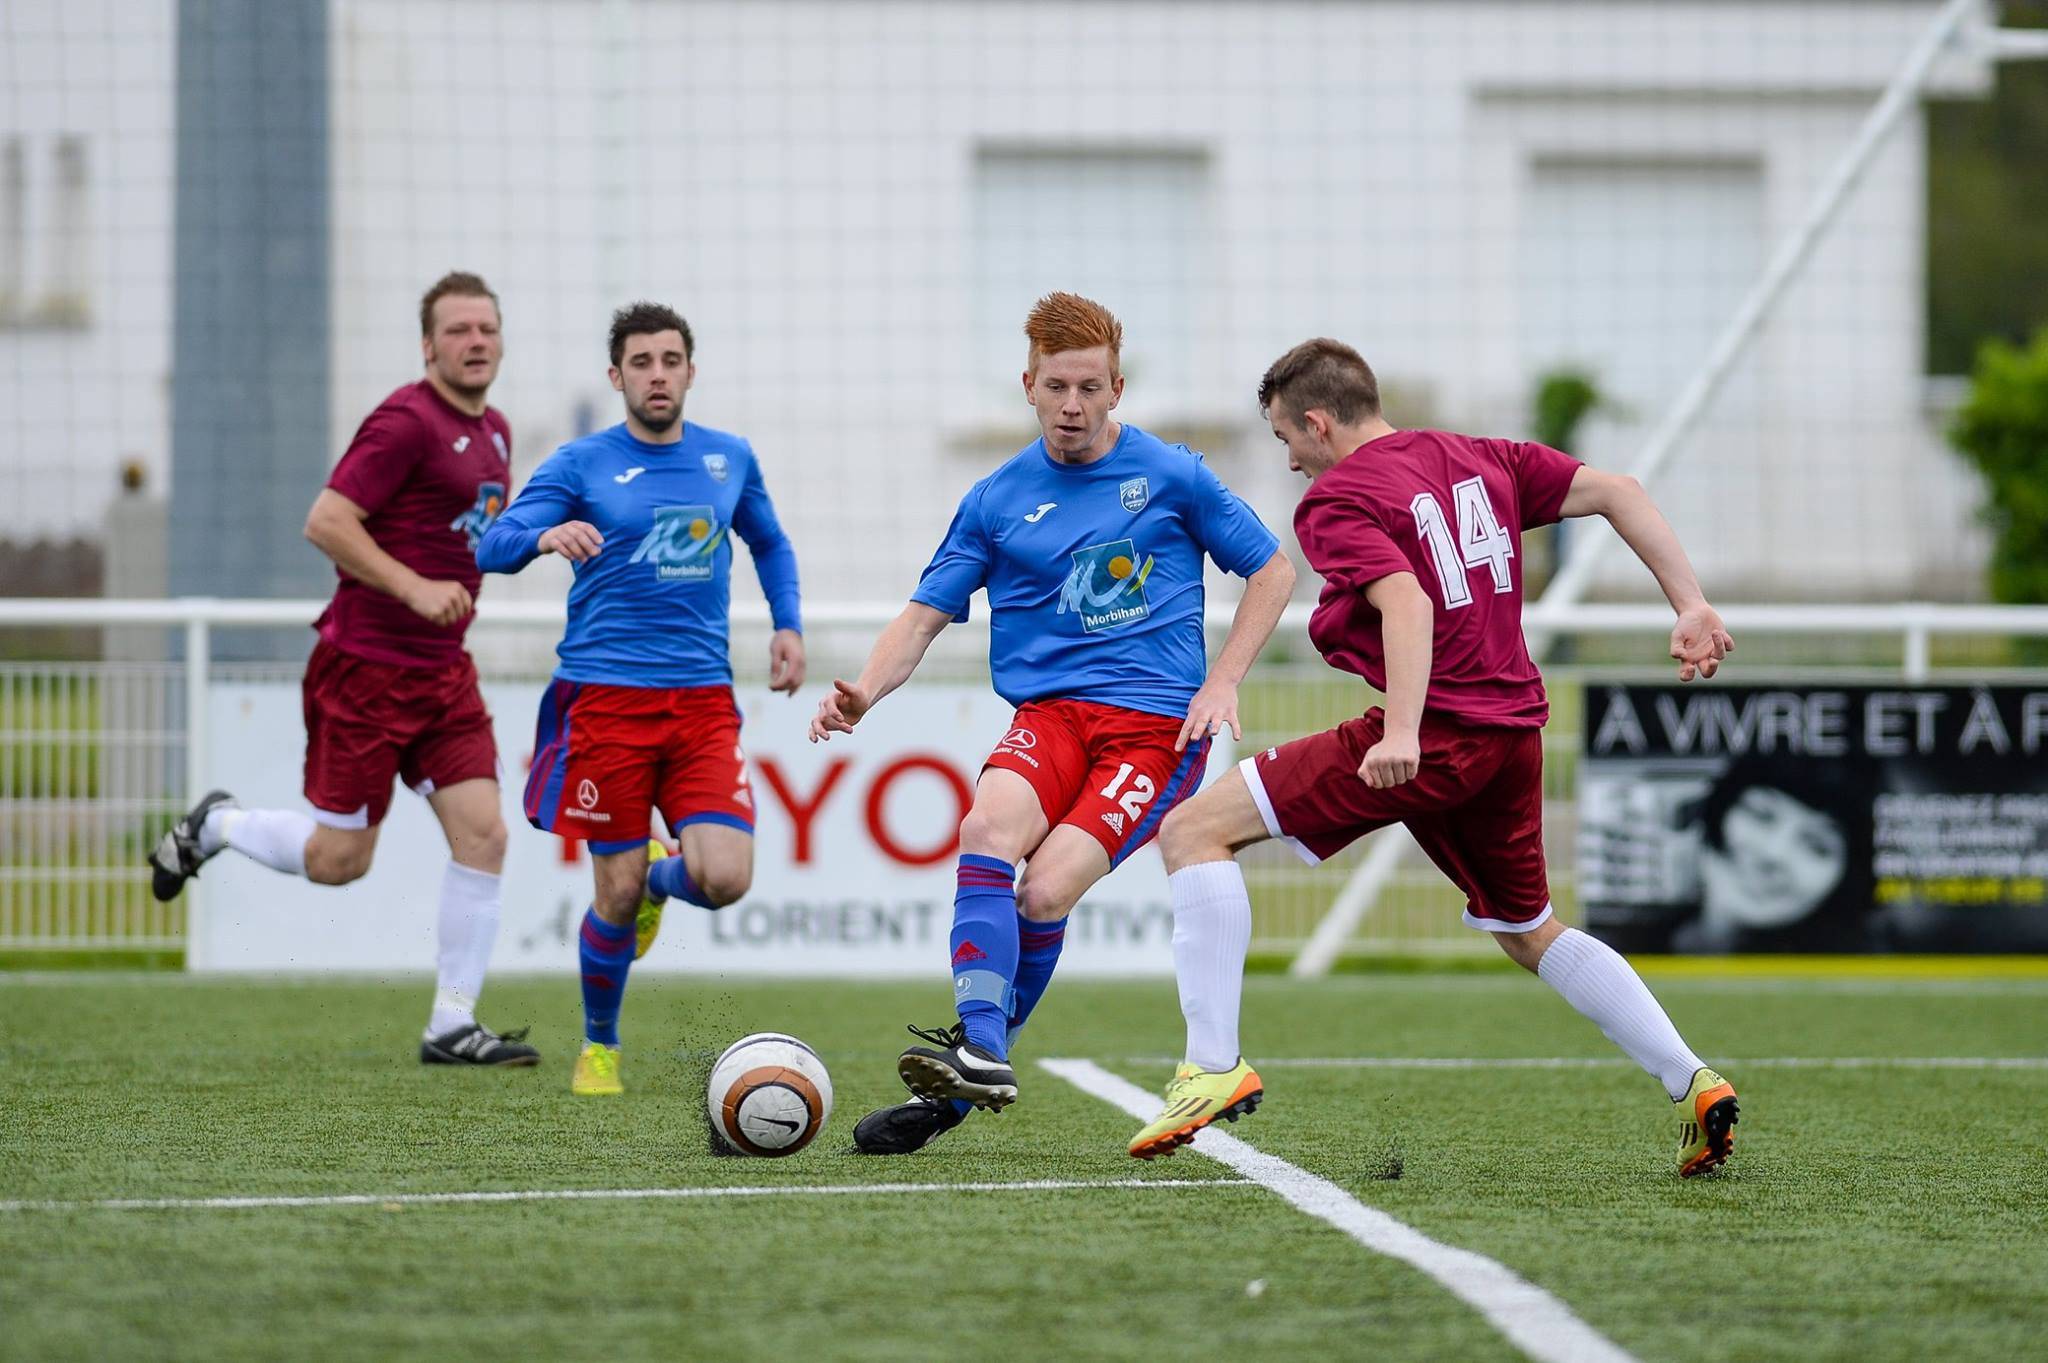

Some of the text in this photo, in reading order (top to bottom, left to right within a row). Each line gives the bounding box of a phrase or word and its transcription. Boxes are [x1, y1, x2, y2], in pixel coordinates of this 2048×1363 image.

[1409, 475, 1515, 610] 14
[660, 565, 710, 577] Morbihan
[1085, 607, 1144, 628] Morbihan
[1593, 684, 1648, 755] À
[1655, 691, 1850, 757] VIVRE
[1864, 691, 1949, 757] ET
[1958, 683, 2012, 755] À
[1100, 762, 1155, 822] 12
[1101, 813, 1123, 837] adidas
[710, 899, 939, 945] LORIENT
